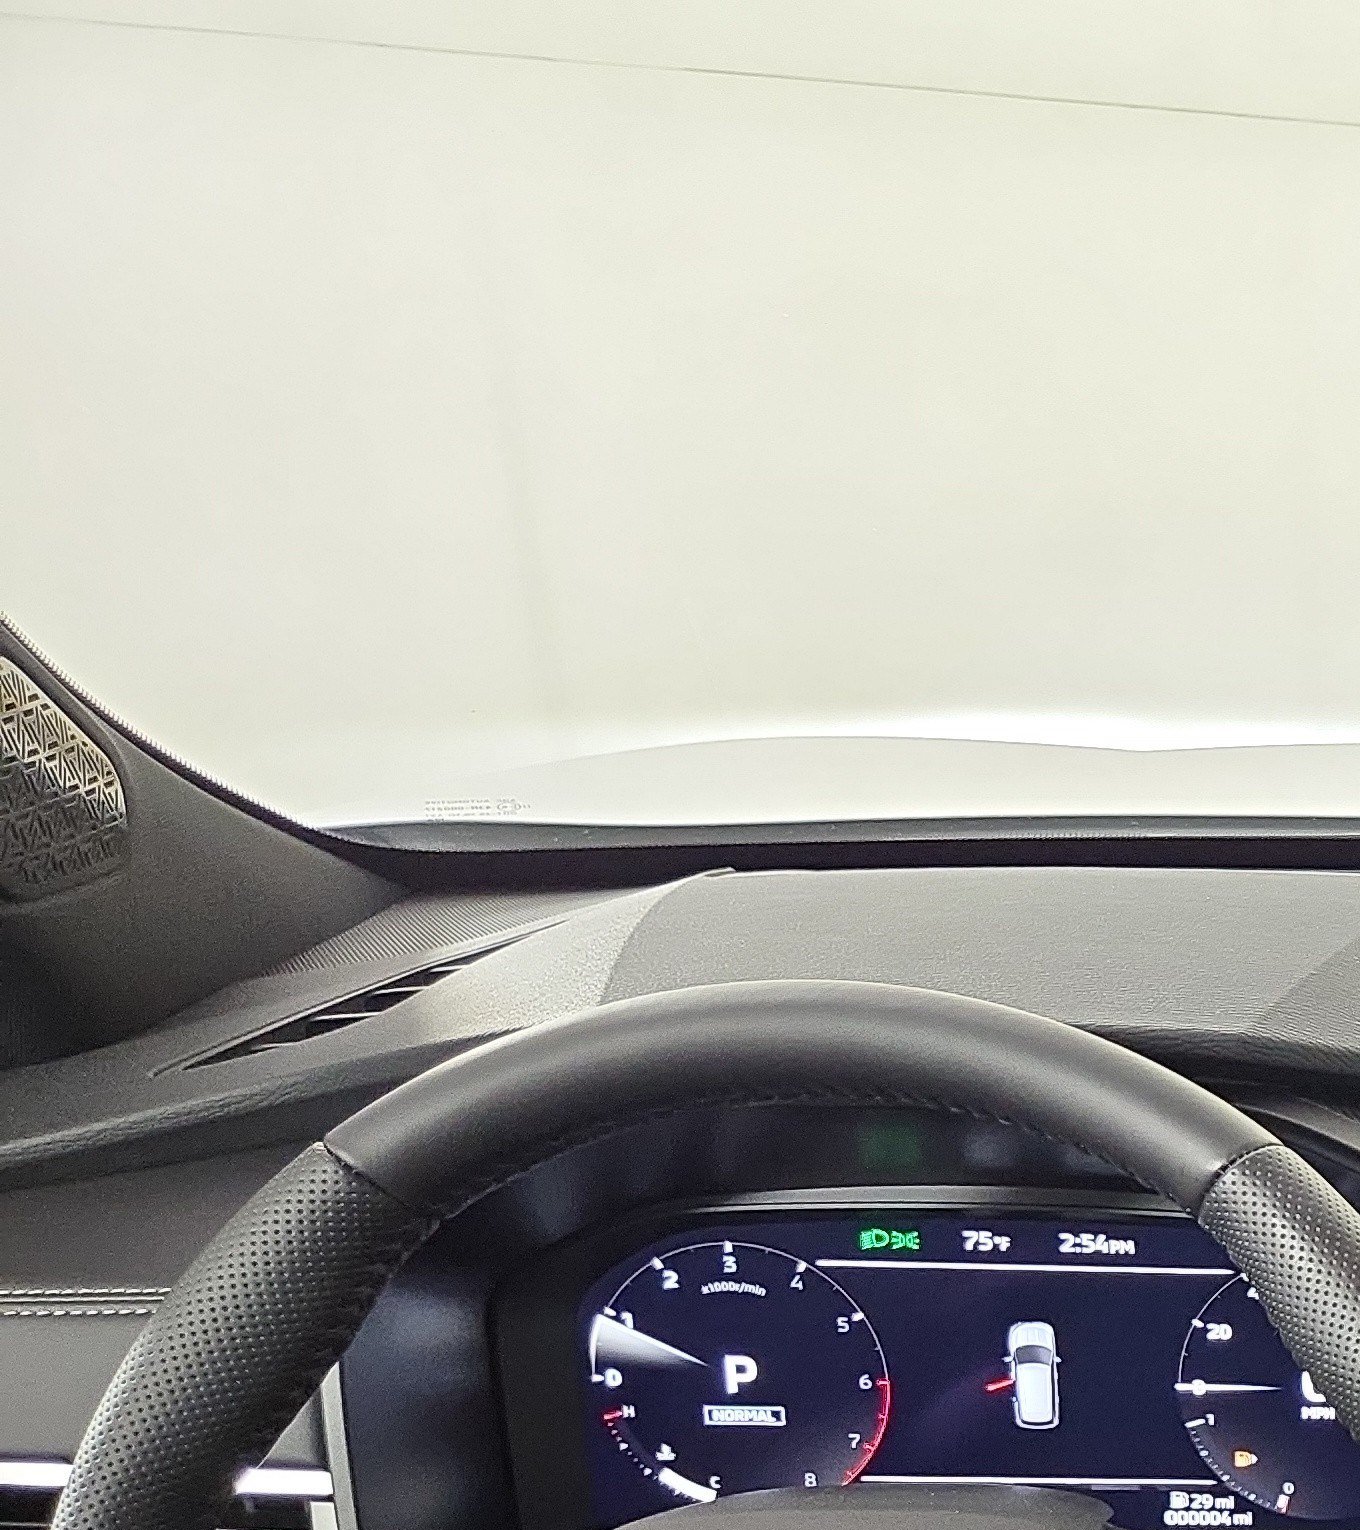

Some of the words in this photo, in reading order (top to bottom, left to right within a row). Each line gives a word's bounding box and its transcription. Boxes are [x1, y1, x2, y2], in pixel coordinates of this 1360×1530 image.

[722, 1256, 737, 1273] 3
[663, 1270, 680, 1290] 2
[790, 1275, 804, 1291] 4
[837, 1317, 850, 1332] 5
[1206, 1322, 1233, 1341] 20
[604, 1369, 623, 1387] 0
[723, 1354, 758, 1394] P
[859, 1374, 873, 1389] 6
[621, 1405, 635, 1418] H
[711, 1408, 777, 1423] NORMAL
[1301, 1405, 1336, 1420] MPH
[848, 1433, 861, 1449] 7
[709, 1476, 721, 1488] C
[804, 1473, 818, 1488] 8
[1282, 1482, 1295, 1495] 0
[1190, 1492, 1214, 1509] 29
[1215, 1493, 1235, 1509] mi
[1163, 1510, 1232, 1526] 000004
[1233, 1510, 1253, 1526] mi
